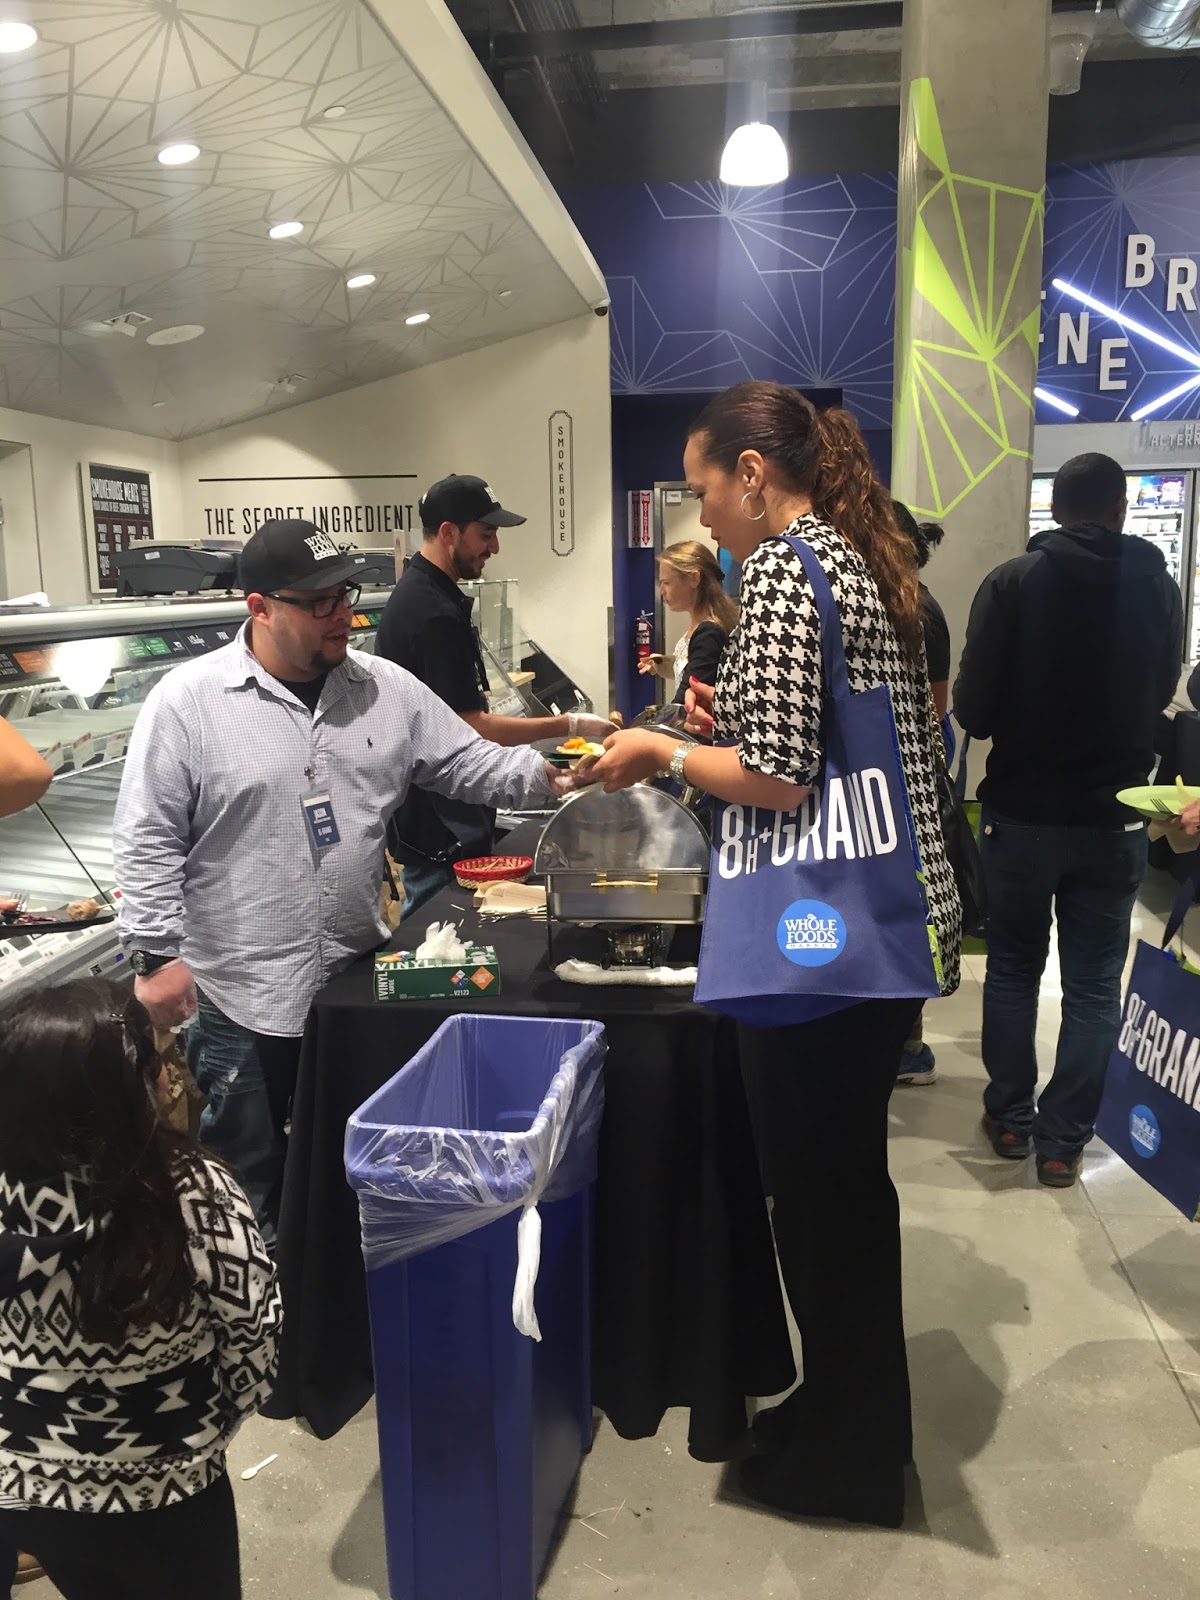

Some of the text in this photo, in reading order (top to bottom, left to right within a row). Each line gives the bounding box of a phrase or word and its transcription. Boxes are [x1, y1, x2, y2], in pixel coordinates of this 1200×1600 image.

[91, 478, 125, 501] SMOKEHOUSE
[557, 426, 566, 541] SMOKEHOUSE
[204, 508, 236, 535] THE
[312, 505, 414, 533] INGREDIENT
[784, 917, 838, 931] WHOLE
[787, 930, 837, 944] FOODS
[377, 971, 389, 997] VINYL
